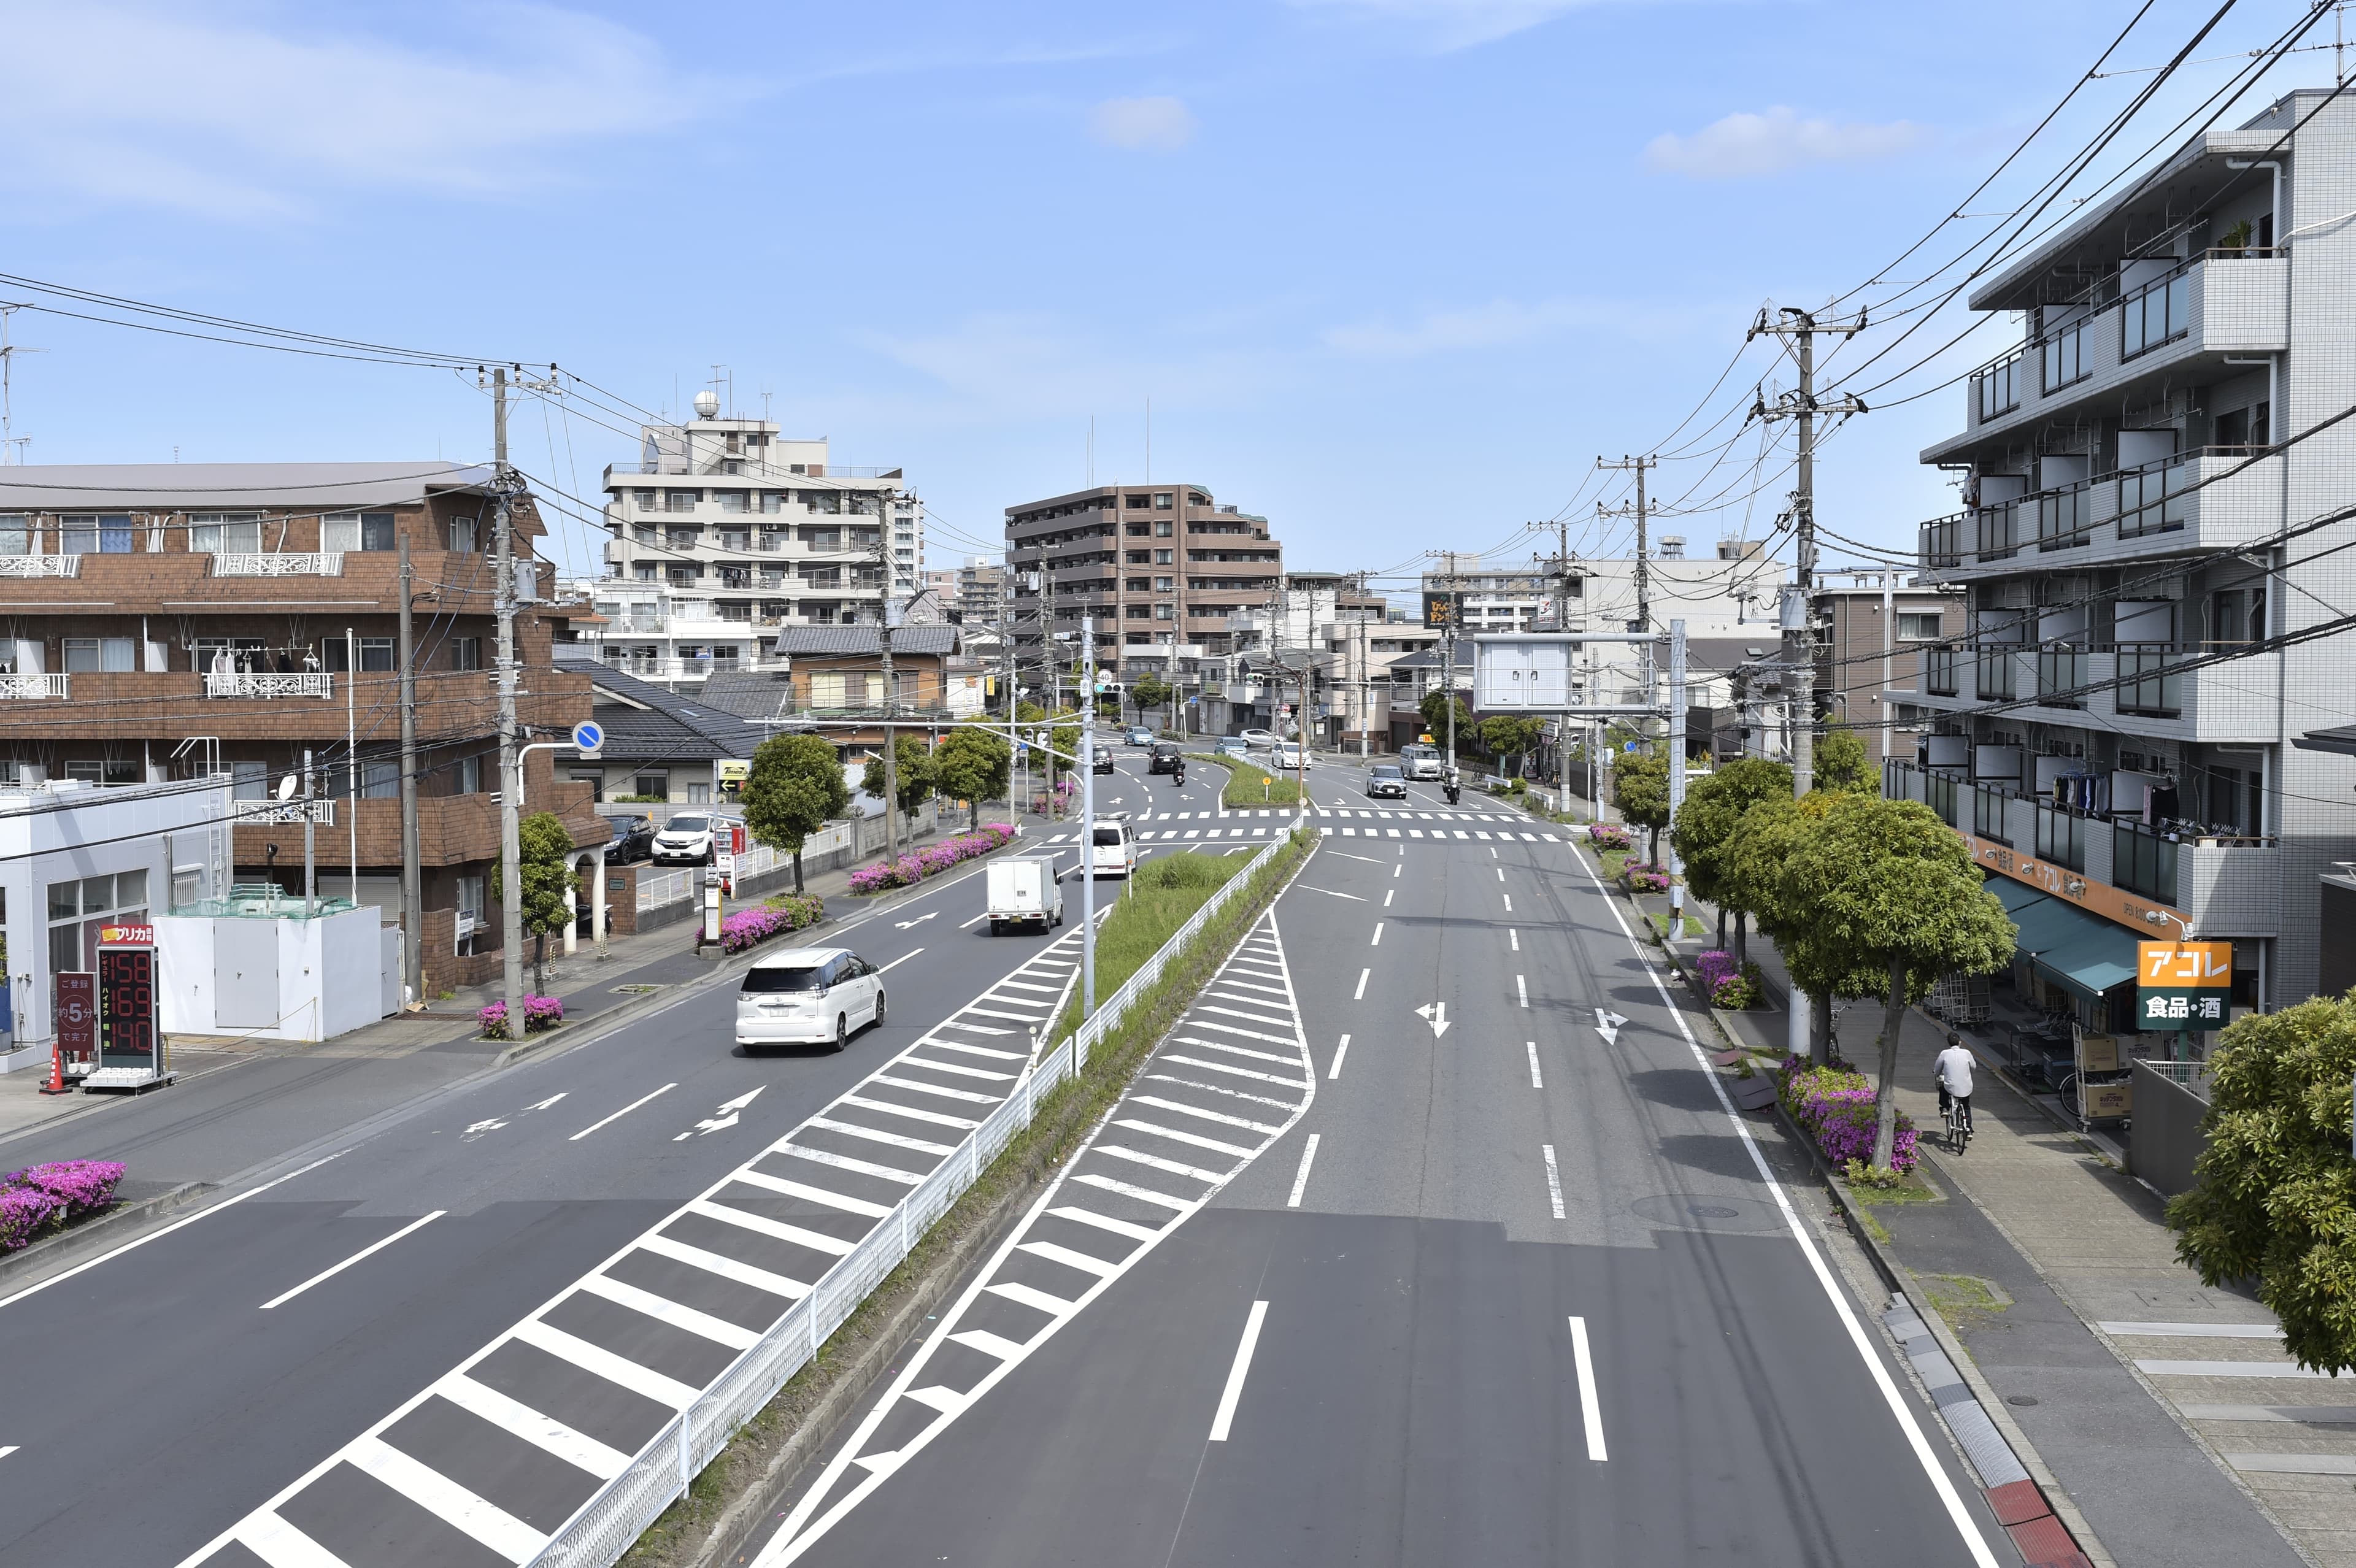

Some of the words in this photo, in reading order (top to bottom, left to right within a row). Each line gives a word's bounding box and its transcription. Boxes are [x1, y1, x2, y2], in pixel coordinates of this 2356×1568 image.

[2043, 865, 2060, 893] アコレ
[2123, 902, 2135, 916] OPEN
[115, 927, 146, 941] プリカ
[110, 953, 150, 983] 158
[2147, 951, 2228, 977] アコレ
[62, 979, 89, 990] ご登録
[58, 1002, 93, 1023] 約5分
[112, 986, 151, 1017] 169
[2146, 996, 2222, 1018] 食品・酒
[62, 1032, 89, 1042] で完了
[112, 1021, 152, 1051] 140
